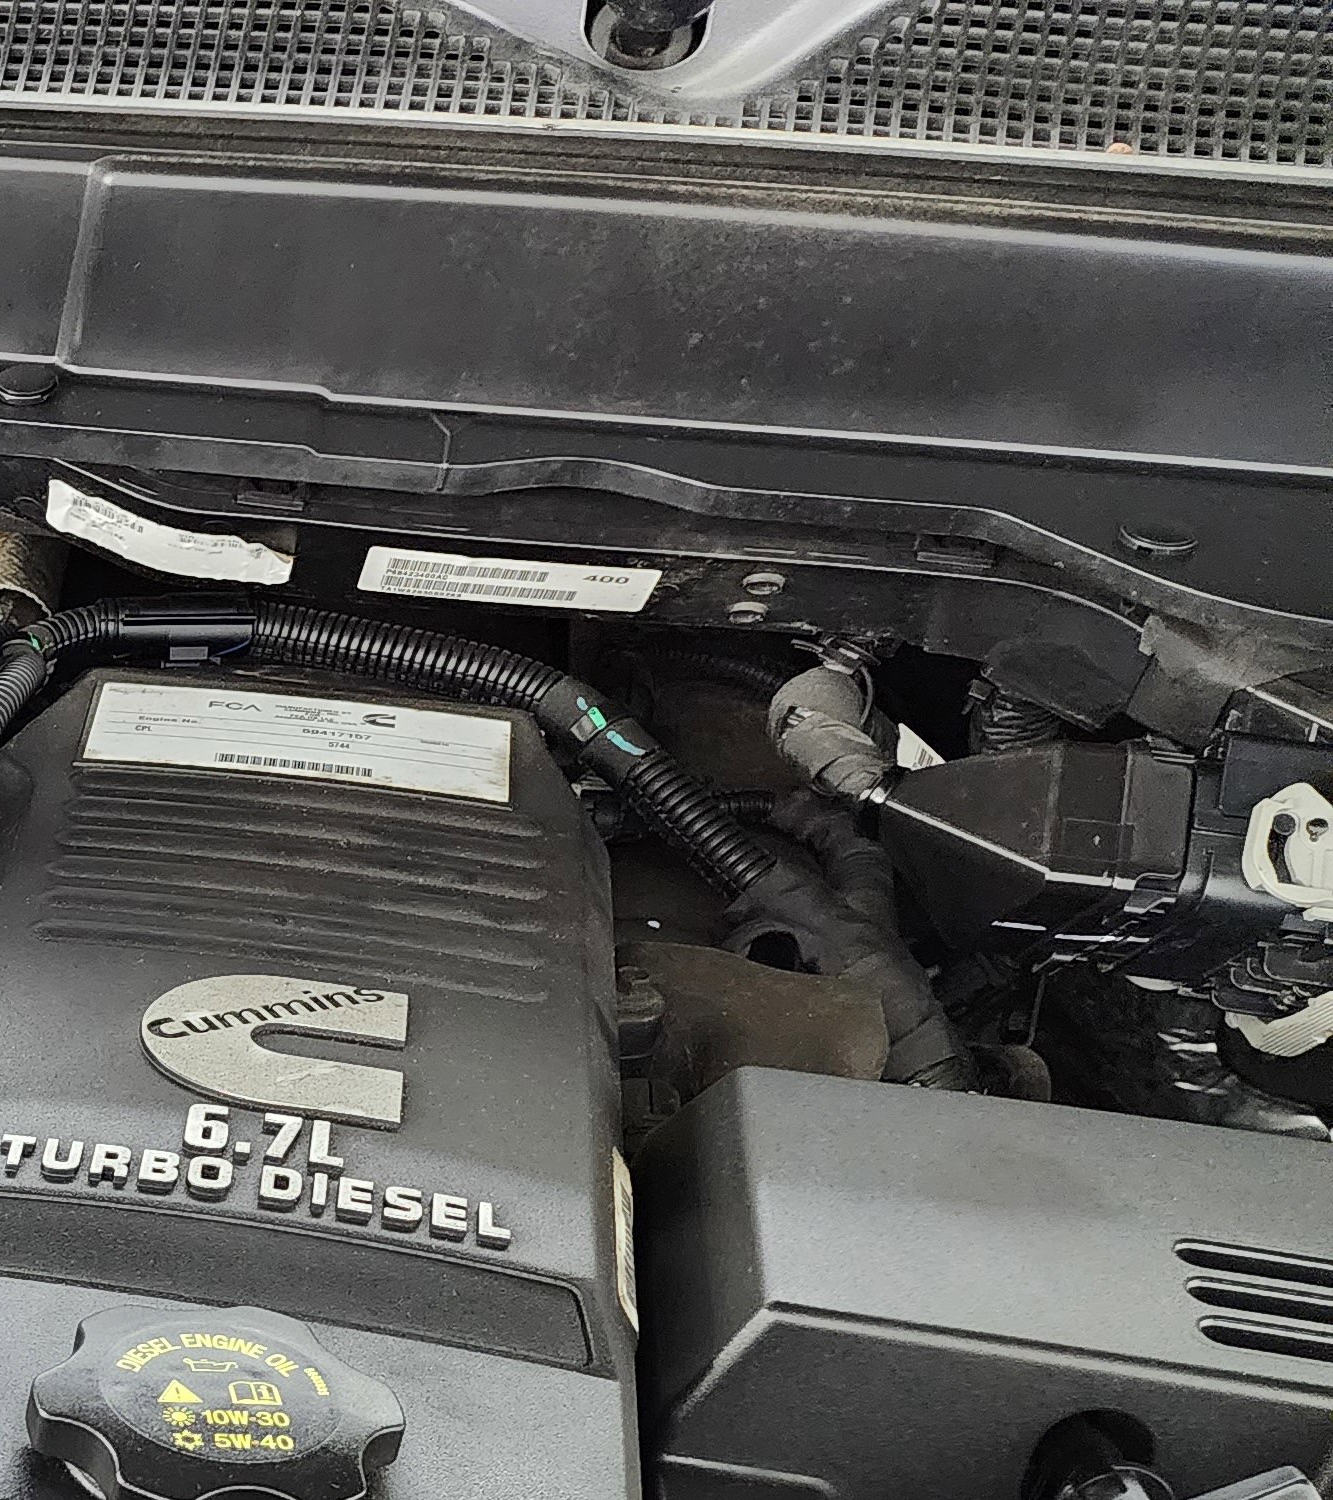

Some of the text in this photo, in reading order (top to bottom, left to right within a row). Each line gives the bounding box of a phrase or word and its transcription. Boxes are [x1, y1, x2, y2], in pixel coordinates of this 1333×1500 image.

[581, 573, 631, 585] 400
[208, 700, 263, 713] FCA
[134, 724, 154, 733] CPL
[328, 740, 351, 750] 5744
[146, 985, 386, 1040] Cummins
[181, 1103, 345, 1174] 6.7L
[0, 1133, 512, 1250] TURBO DIESEL
[115, 1333, 300, 1378] DIESEL ENGINE OIL
[201, 1409, 291, 1428] 10W-30
[213, 1433, 295, 1450] 5W-40
